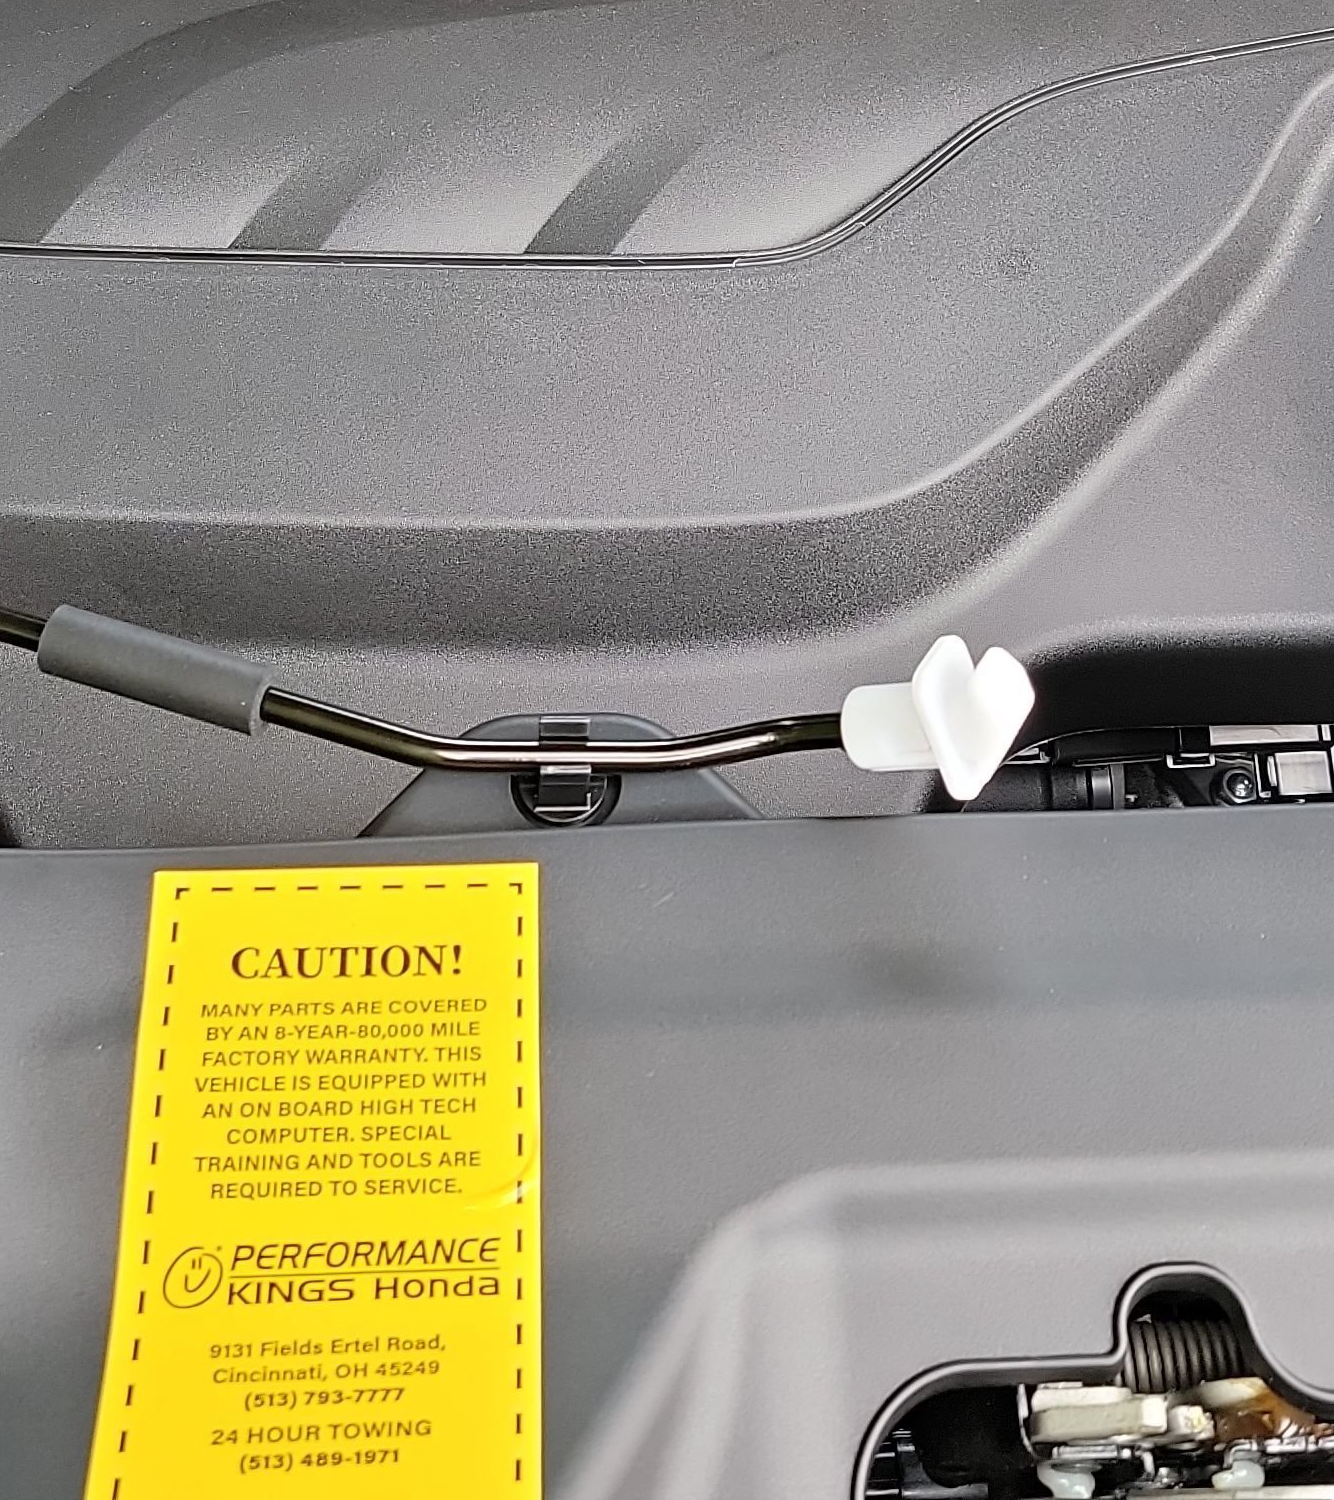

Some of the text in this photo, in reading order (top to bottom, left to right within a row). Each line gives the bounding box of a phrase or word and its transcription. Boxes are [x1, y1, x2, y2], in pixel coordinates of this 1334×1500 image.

[230, 944, 461, 979] CAUTION!
[200, 998, 487, 1017] MANY PARTS ARE COVERED
[206, 1021, 479, 1041] BY AN 8-YEAR-80,000 MILE
[201, 1046, 481, 1066] FACTORY WARRANTY. THIS
[194, 1071, 486, 1092] VEHICLE IS EQUIPPED WITH
[201, 1097, 475, 1118] AN ON BOARD HIGH TECH
[226, 1124, 451, 1144] COMPUTER. SPECIAL
[194, 1150, 480, 1172] TRAINING AND TOOLS ARE
[210, 1178, 462, 1200] REQUIRED TO SERVICE.
[230, 1237, 501, 1271] PERFORMANCE
[227, 1275, 499, 1305] KINGS Honda
[210, 1333, 445, 1358] 9131 Fields Ertel Road,
[212, 1360, 439, 1383] Cincinnati, OH 45249
[244, 1387, 404, 1411] (513) 793-7777
[210, 1419, 431, 1445] 24 HOUR TOWING
[239, 1449, 398, 1474] (513) 489-1971
